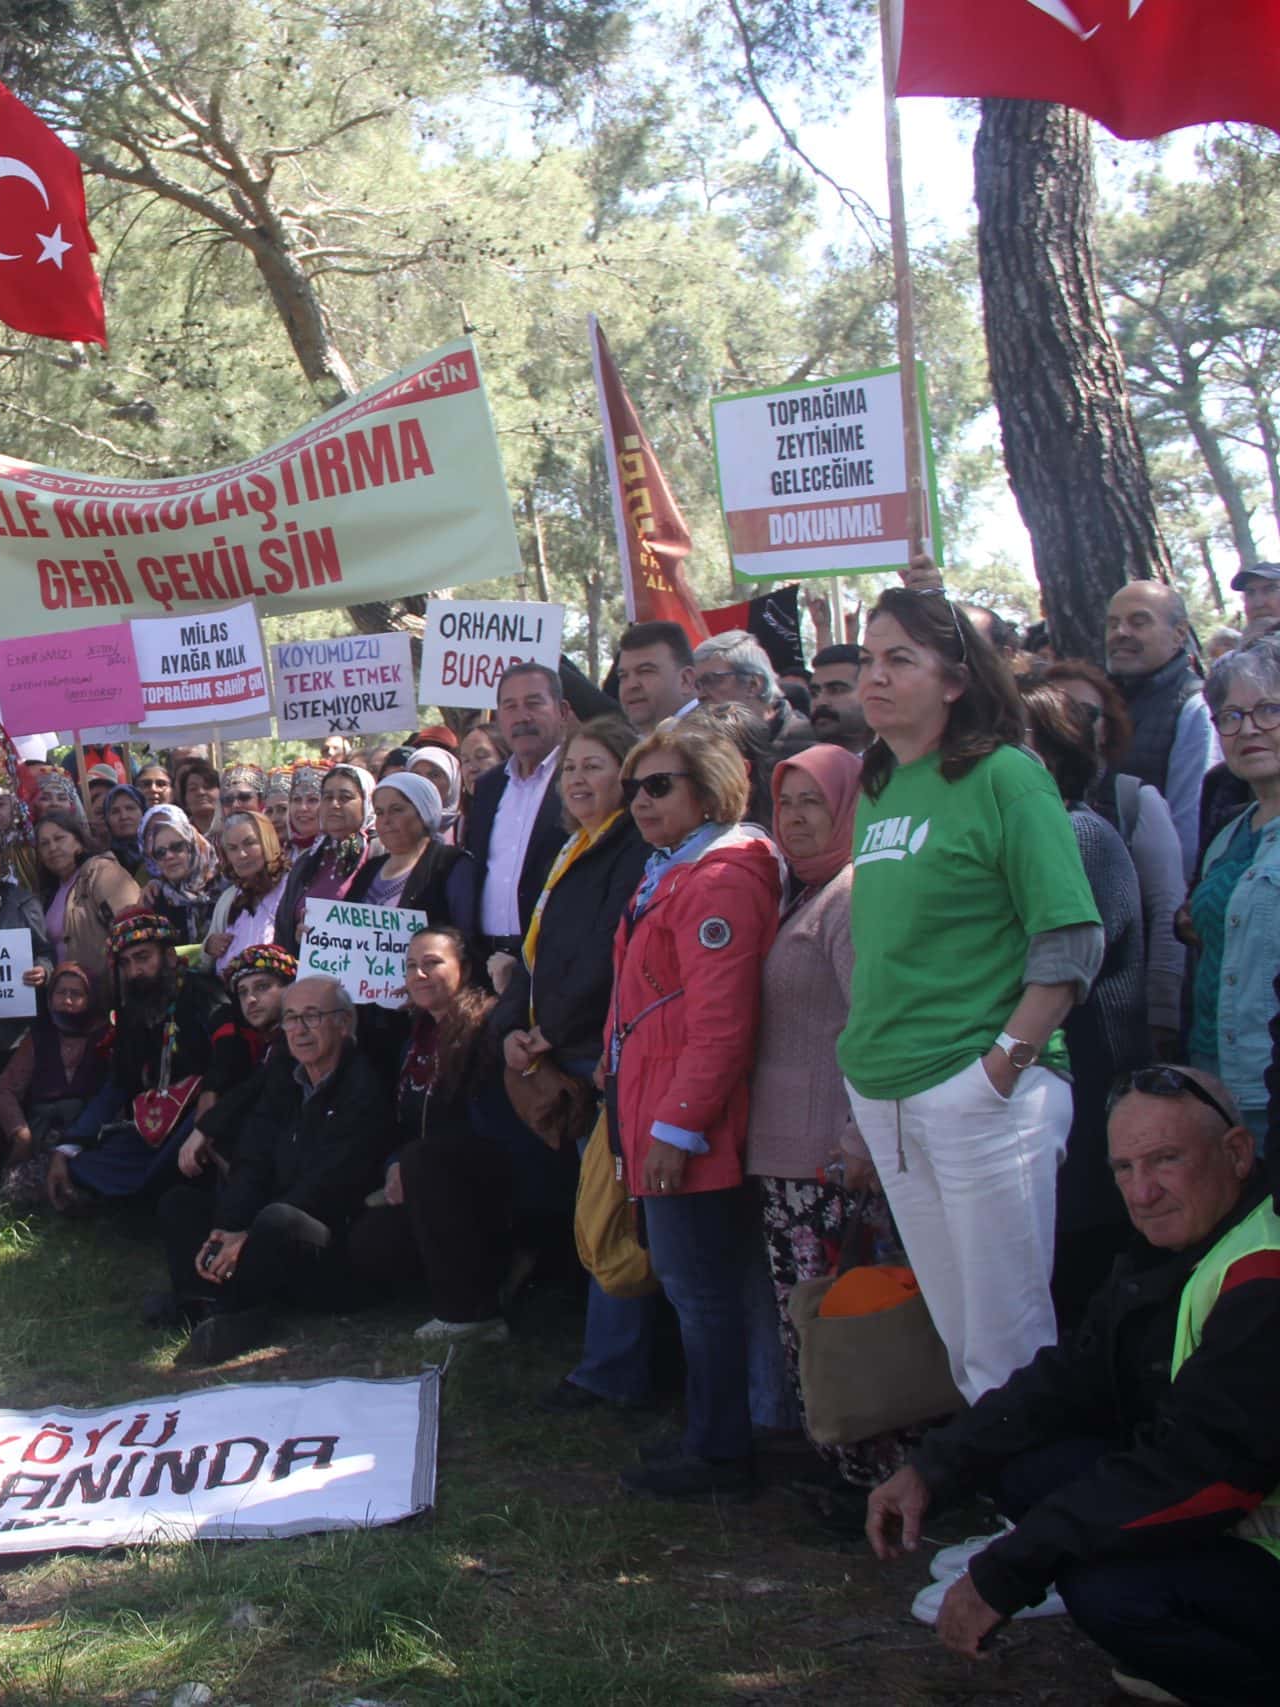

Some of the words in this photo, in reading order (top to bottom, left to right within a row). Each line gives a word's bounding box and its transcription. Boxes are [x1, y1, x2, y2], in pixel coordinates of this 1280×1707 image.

[767, 387, 868, 427] TOPRAĞIMA
[26, 473, 161, 496] ZEYTİNİMİZ
[417, 362, 468, 392] İÇİN
[776, 423, 865, 460] ZEYTİNİME
[52, 418, 435, 538] KAMULAŞTIRMA
[771, 457, 875, 496] GELECEĞİME
[768, 503, 884, 545] DOKUNMA!
[36, 549, 135, 610] GERİ
[136, 521, 343, 611] ÇEKİLSİN
[180, 621, 229, 647] MİLAS
[440, 612, 543, 643] ORHANLI
[161, 648, 211, 675] AYAĞA
[215, 644, 246, 669] KALK
[441, 650, 536, 688] BURA
[143, 680, 212, 705] TOPRAĞINA
[215, 673, 246, 698] SAHİP
[283, 670, 336, 694] TERK
[343, 663, 402, 688] ETMEK
[860, 815, 912, 853] TEMA
[305, 926, 353, 950] Yağma
[356, 939, 370, 951] ve
[308, 950, 351, 976] Geçit
